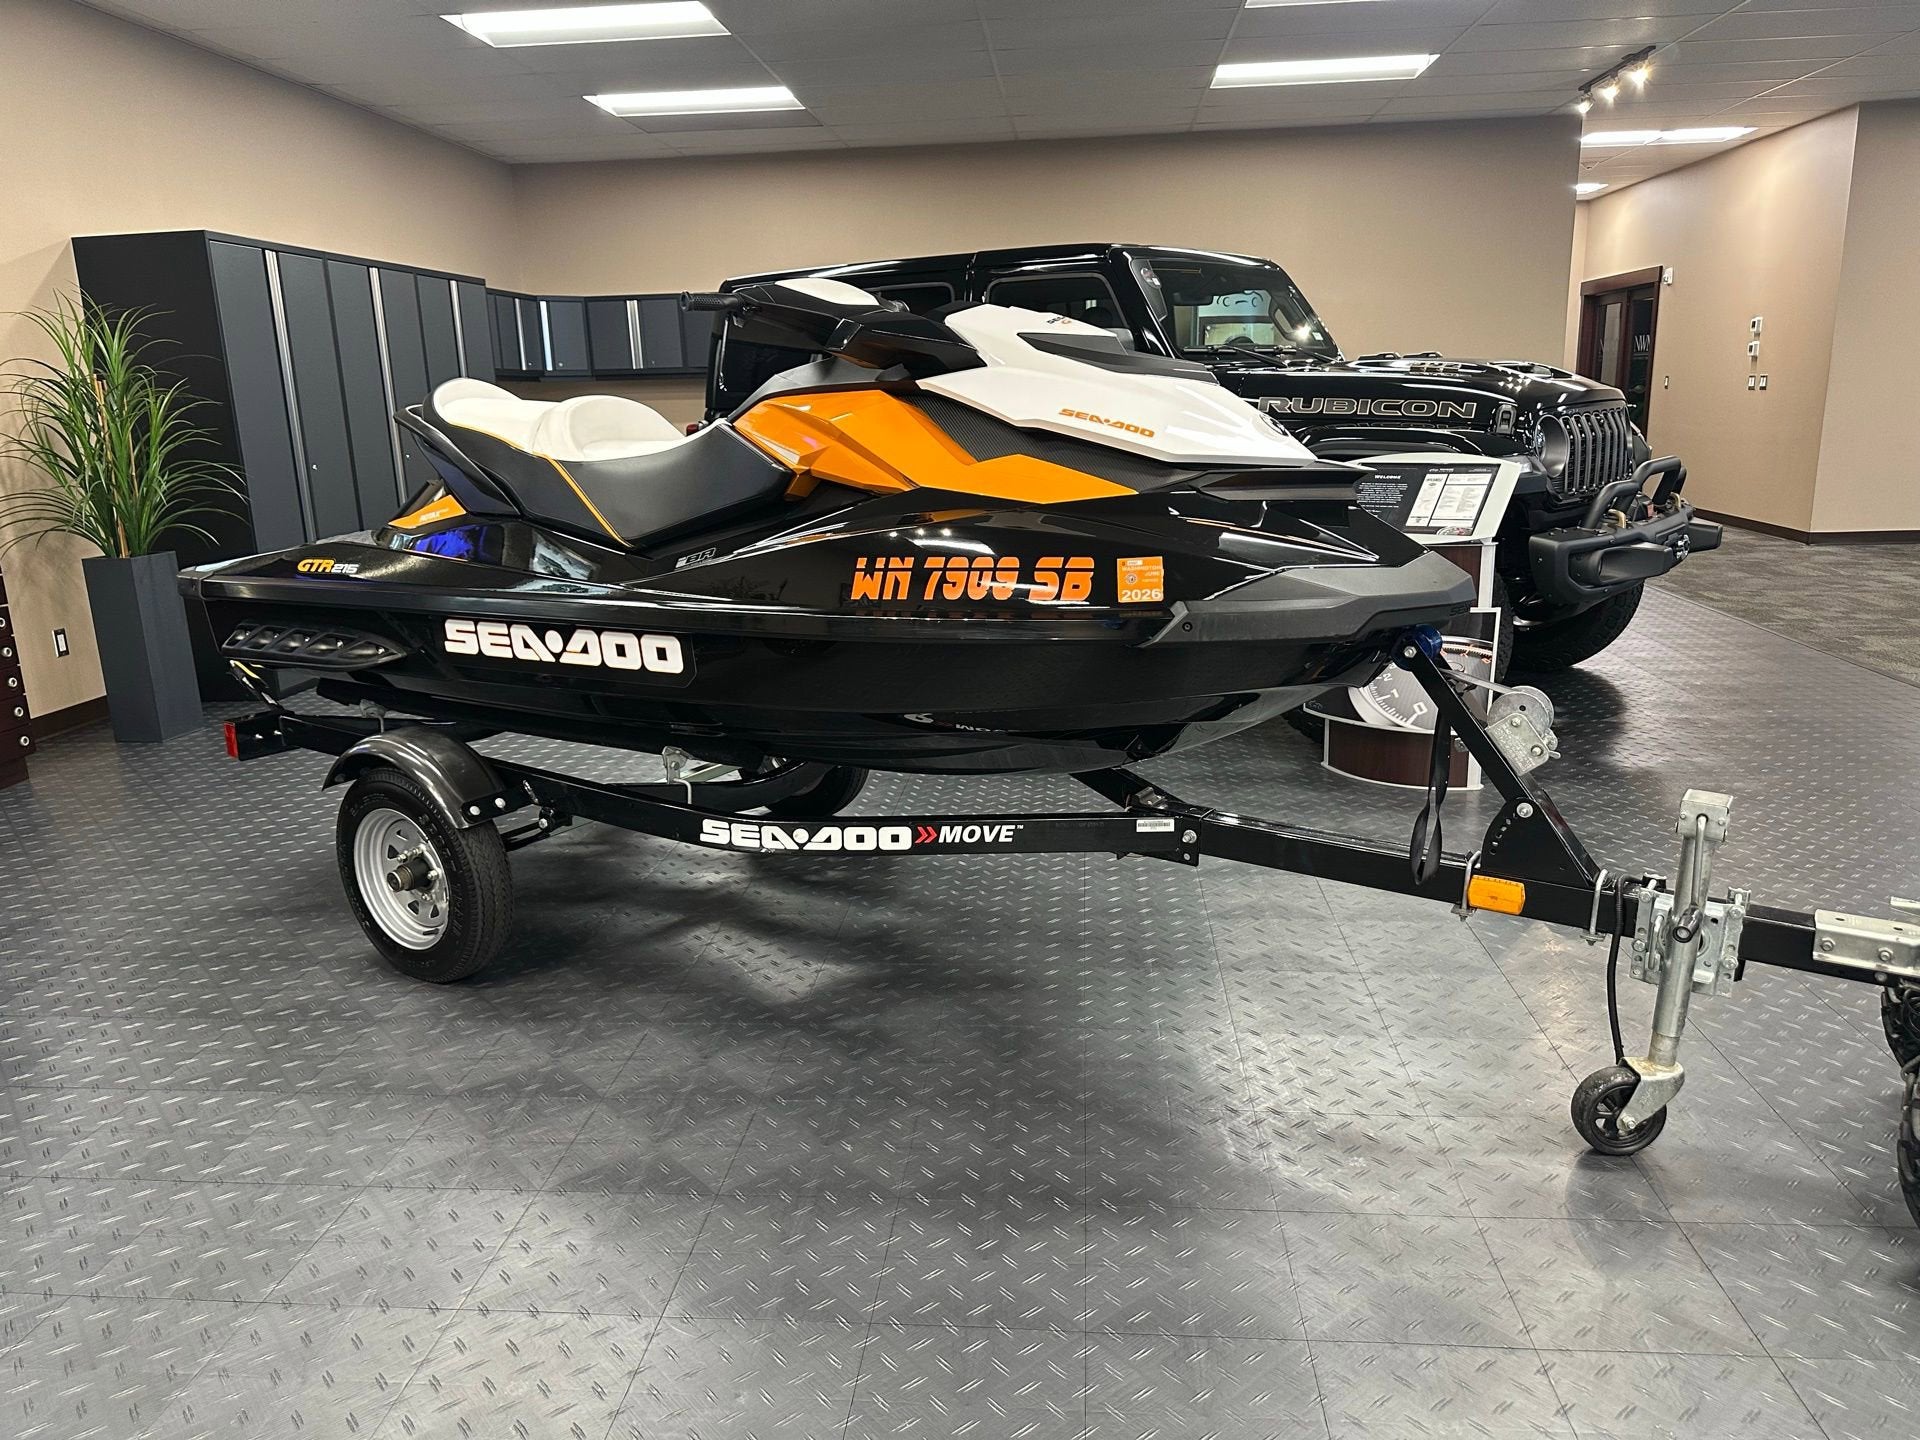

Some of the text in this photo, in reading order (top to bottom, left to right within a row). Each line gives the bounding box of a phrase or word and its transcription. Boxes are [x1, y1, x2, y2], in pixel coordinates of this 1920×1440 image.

[1257, 396, 1478, 419] RUBICON
[850, 556, 915, 601] WN
[1028, 556, 1095, 601] SB
[1121, 589, 1162, 600] 2026
